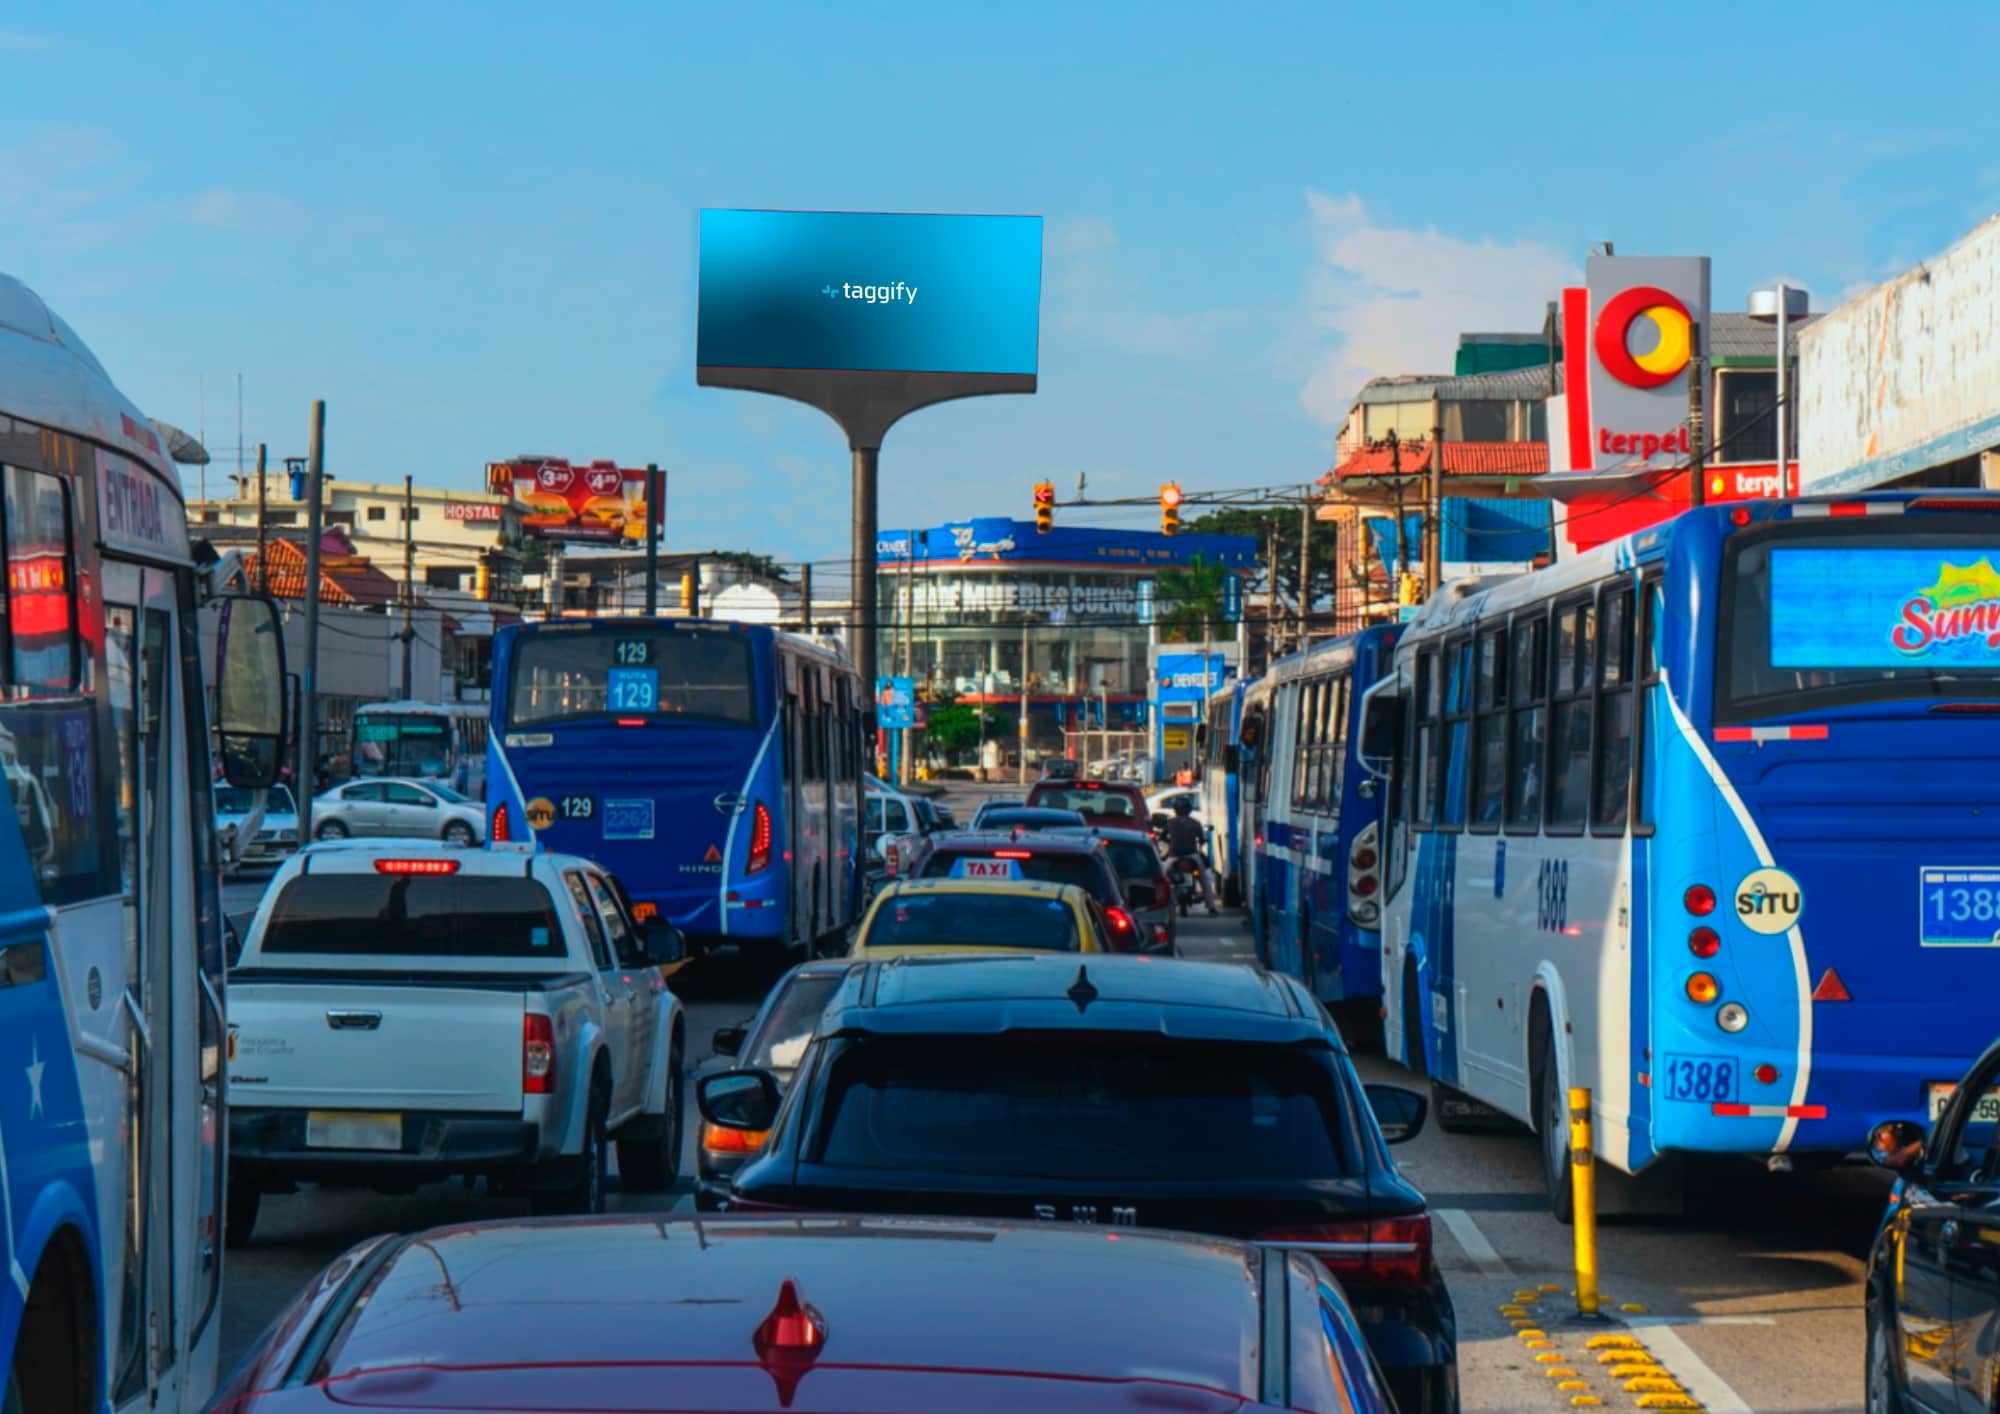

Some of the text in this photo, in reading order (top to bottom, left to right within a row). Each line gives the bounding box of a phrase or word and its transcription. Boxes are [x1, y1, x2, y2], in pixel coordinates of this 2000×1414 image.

[843, 281, 918, 305] taggify
[1599, 427, 1691, 461] terpel
[105, 468, 164, 544] ENTRADA
[446, 503, 500, 520] HOSTAL
[617, 641, 648, 664] 129
[613, 681, 653, 709] 129
[560, 796, 592, 817] 129
[679, 864, 723, 873] HINO
[967, 861, 1008, 877] TAXI
[1537, 857, 1569, 934] 1388
[1666, 1059, 1732, 1101] 1388
